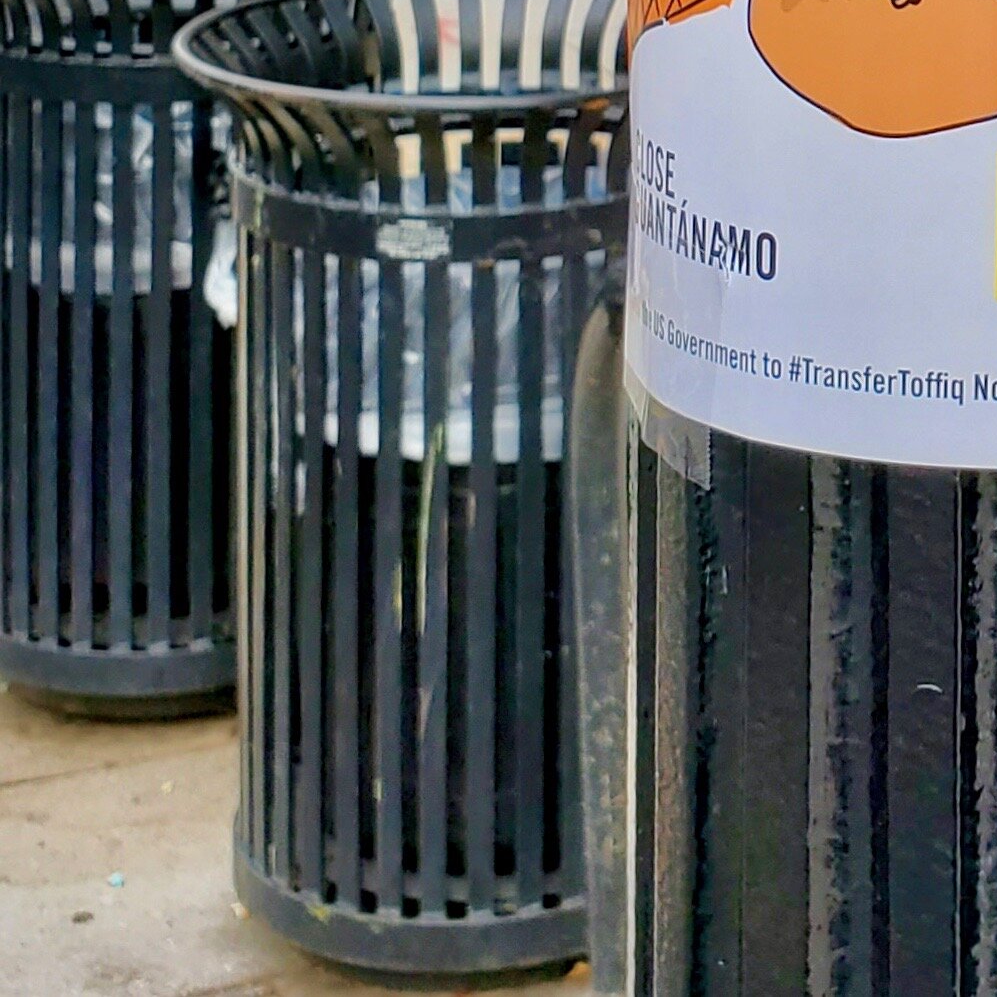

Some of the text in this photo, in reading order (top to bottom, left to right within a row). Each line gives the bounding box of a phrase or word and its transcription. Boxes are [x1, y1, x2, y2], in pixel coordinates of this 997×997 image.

[637, 181, 778, 281] UANTÁNAMO
[653, 309, 665, 340] US
[667, 319, 757, 375] Government
[763, 352, 782, 379] to
[788, 355, 964, 405] #TransferToffiq
